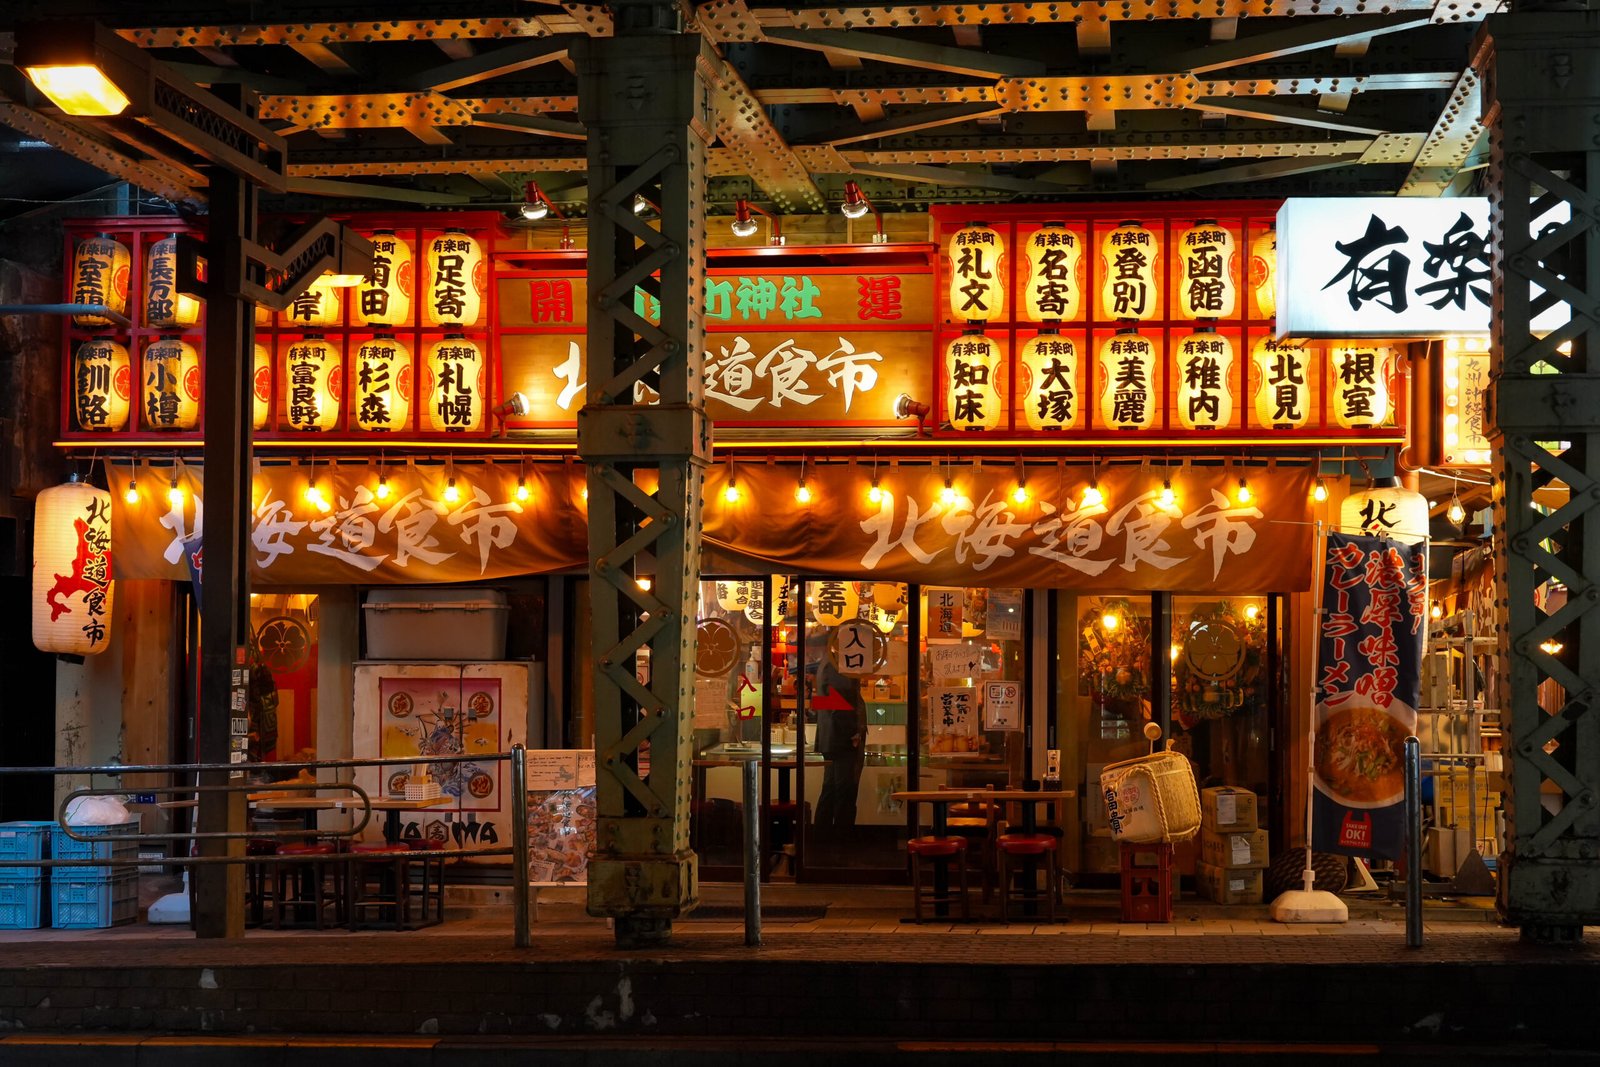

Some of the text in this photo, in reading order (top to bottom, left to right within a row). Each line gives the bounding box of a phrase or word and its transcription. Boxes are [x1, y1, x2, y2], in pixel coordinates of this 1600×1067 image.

[373, 240, 396, 254] 楽町
[433, 239, 471, 253] 有楽町
[956, 231, 996, 246] 有楽町
[1034, 232, 1074, 247] 有楽町
[1110, 231, 1150, 246] 有楽町
[1185, 230, 1226, 246] 有楽町
[148, 257, 175, 320] 長万部
[434, 255, 467, 318] 足寄
[529, 280, 573, 323] 開
[857, 275, 902, 320] 運
[957, 247, 992, 311] 礼文
[1036, 248, 1069, 315] 名寄
[1113, 247, 1147, 314] 登別
[1187, 246, 1226, 312] 函館
[80, 347, 114, 361] 有楽町
[146, 347, 183, 362] 有楽町
[289, 346, 327, 361] 有楽町
[359, 345, 396, 361] 有楽町
[437, 346, 476, 361] 有楽町
[952, 341, 991, 356] 有楽町
[1035, 341, 1074, 356] 有楽町
[1110, 340, 1149, 356] 有楽町
[1183, 340, 1224, 355] 有楽町
[77, 363, 110, 425] 釧路
[147, 363, 182, 424] 小樽
[290, 361, 320, 425] 富良野
[359, 362, 391, 424] 杉森
[438, 362, 472, 426] 札幌
[954, 358, 989, 423] 知床
[1038, 358, 1074, 422] 大塚
[1112, 356, 1147, 423] 美麗
[1185, 356, 1220, 422] 稚内
[1269, 354, 1305, 420] 北見
[1340, 353, 1375, 419] 根室
[860, 488, 1264, 582] 北海道食市
[82, 496, 111, 647] 北海道食市
[939, 593, 954, 633] 北海道
[1321, 542, 1365, 707] カレーラーメン
[1354, 547, 1406, 708] 濃厚味噌
[845, 627, 865, 668] 入口
[736, 674, 757, 720] 入口
[941, 692, 953, 727] 営業中
[956, 694, 969, 723] 元気に
[1345, 829, 1366, 841] OK!
